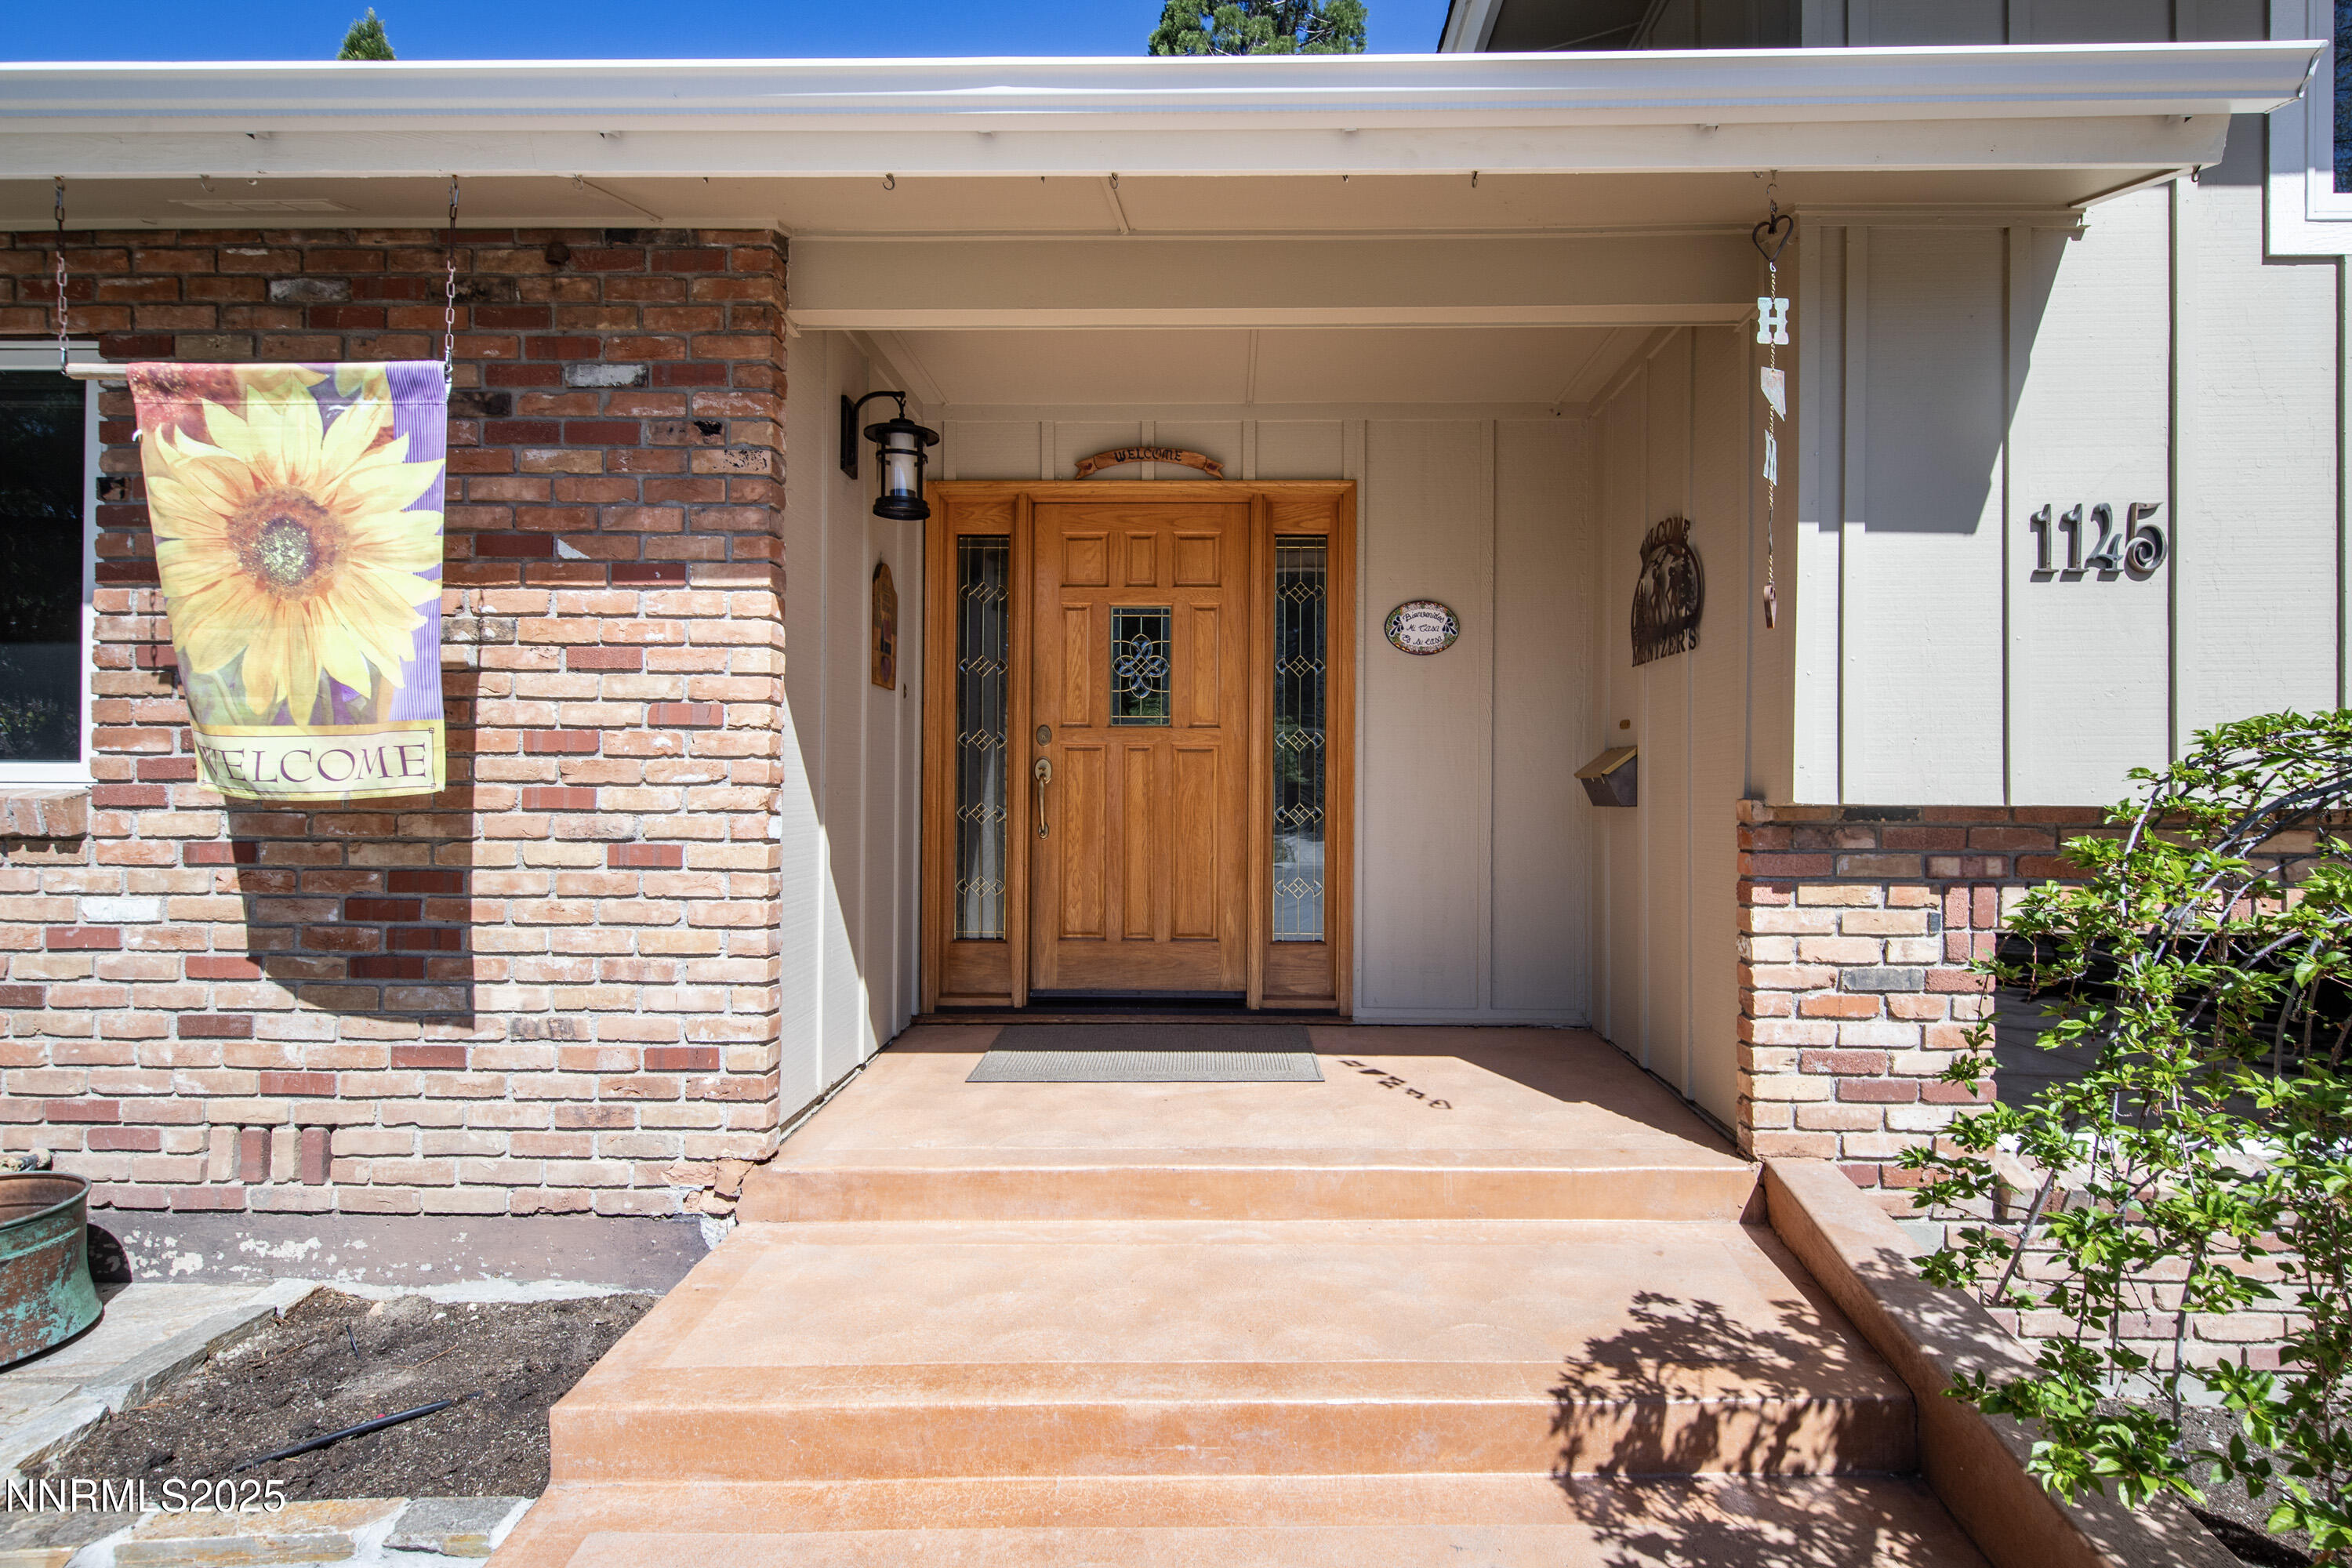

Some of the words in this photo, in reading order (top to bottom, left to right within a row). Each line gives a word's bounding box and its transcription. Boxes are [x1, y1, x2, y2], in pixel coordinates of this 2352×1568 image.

[1113, 447, 1183, 463] WELCOME
[2030, 501, 2168, 583] 1125
[197, 742, 426, 783] WELCOME
